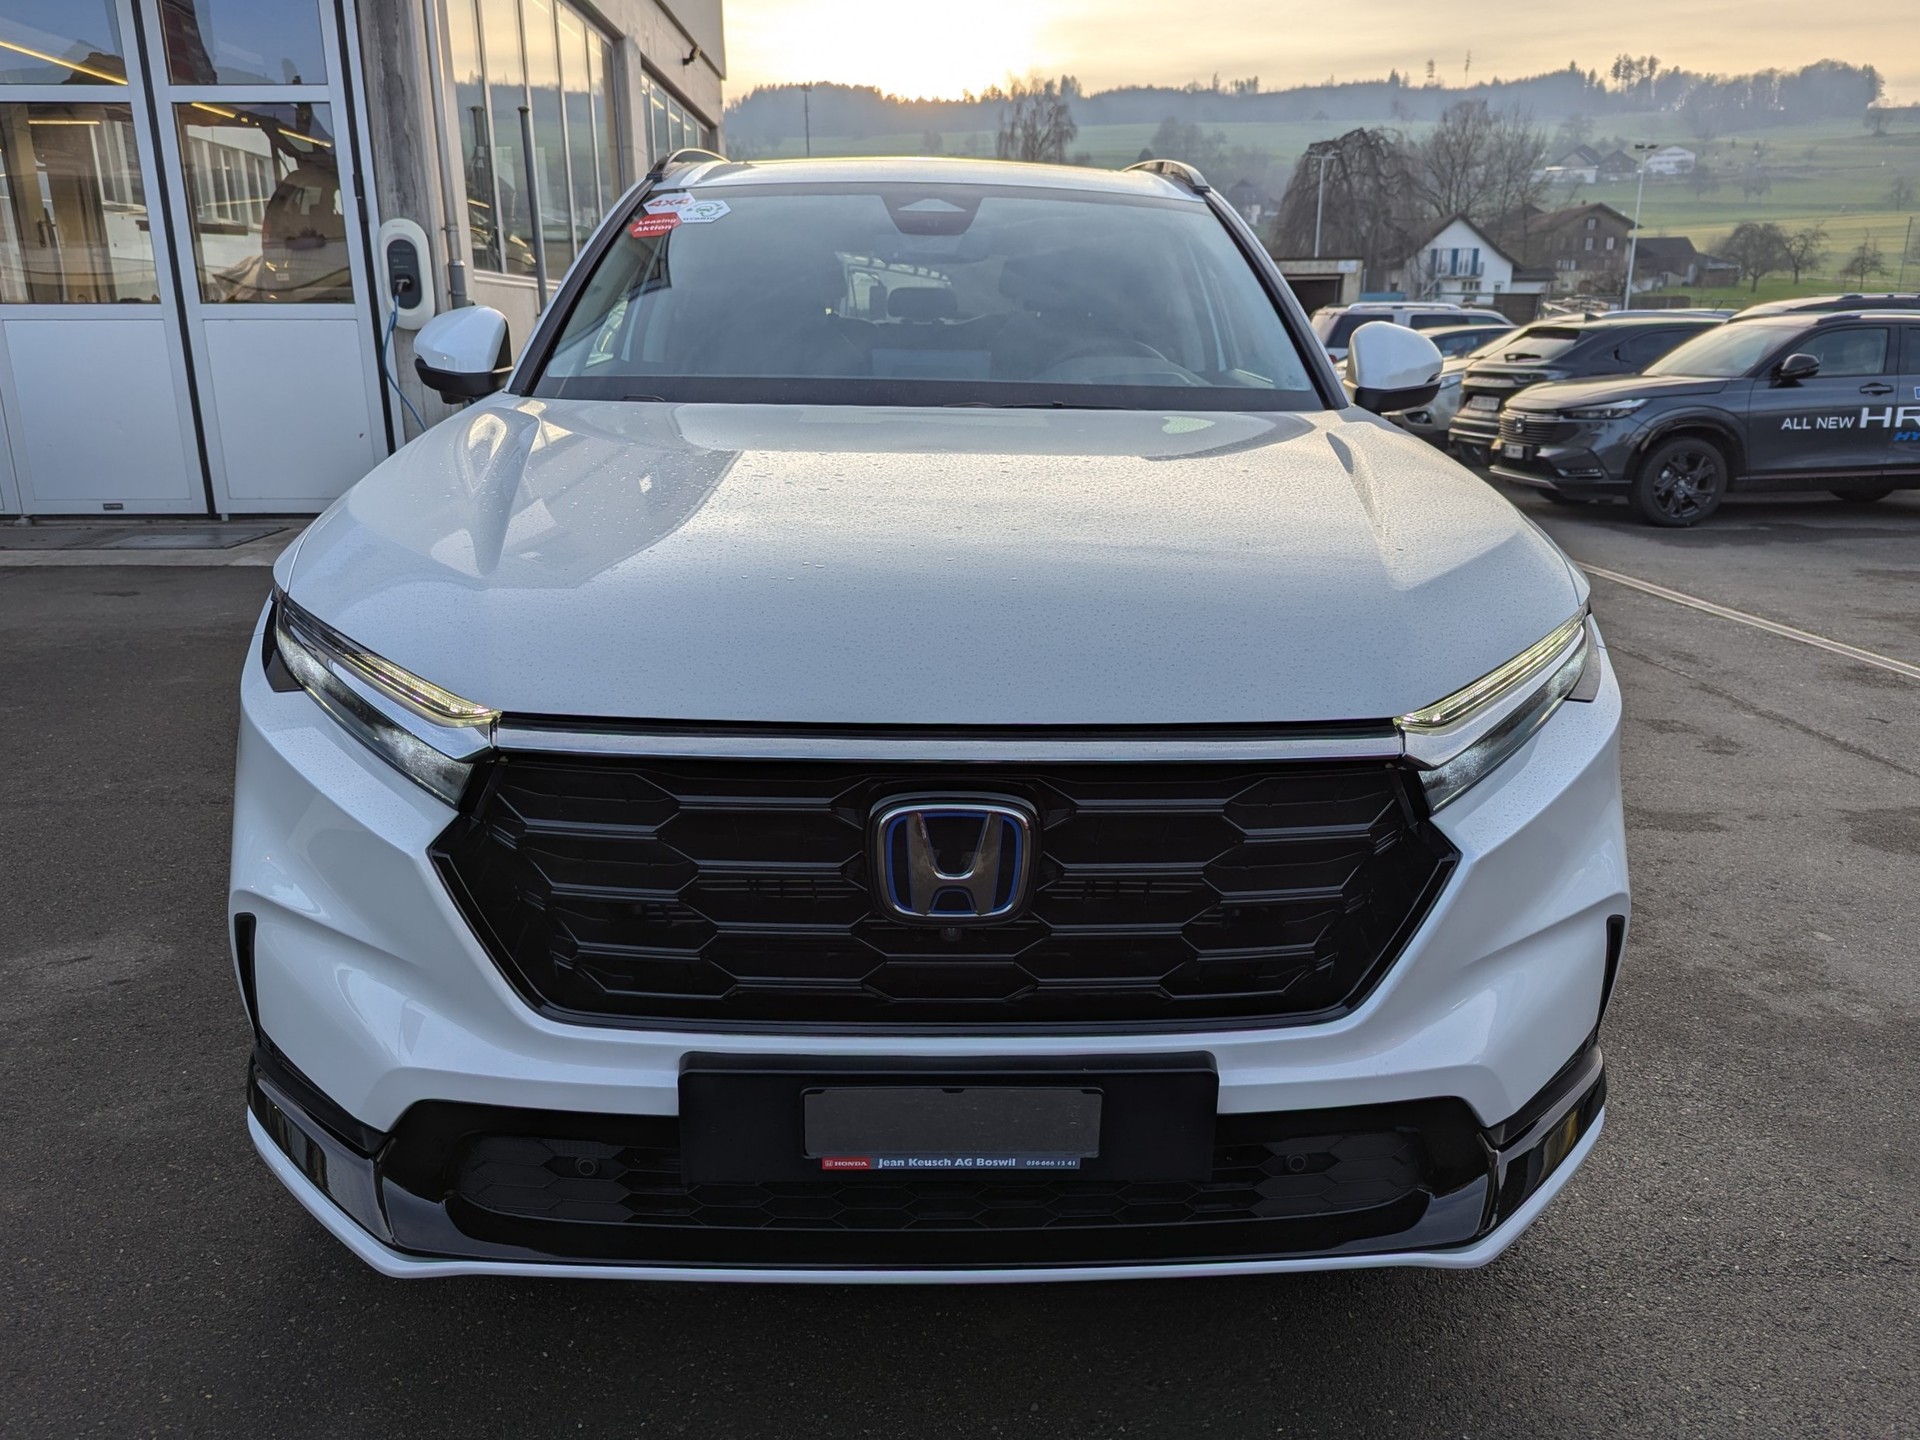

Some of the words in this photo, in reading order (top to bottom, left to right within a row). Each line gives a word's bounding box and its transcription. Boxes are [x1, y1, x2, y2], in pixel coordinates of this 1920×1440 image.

[638, 218, 677, 226] Leasing
[634, 225, 672, 233] Aktion
[1781, 417, 1812, 430] ALL
[1816, 416, 1855, 429] NEW
[878, 1158, 904, 1169] Jean
[908, 1158, 952, 1167] Keusch
[954, 1158, 973, 1167] AG
[976, 1158, 1016, 1167] Boswil
